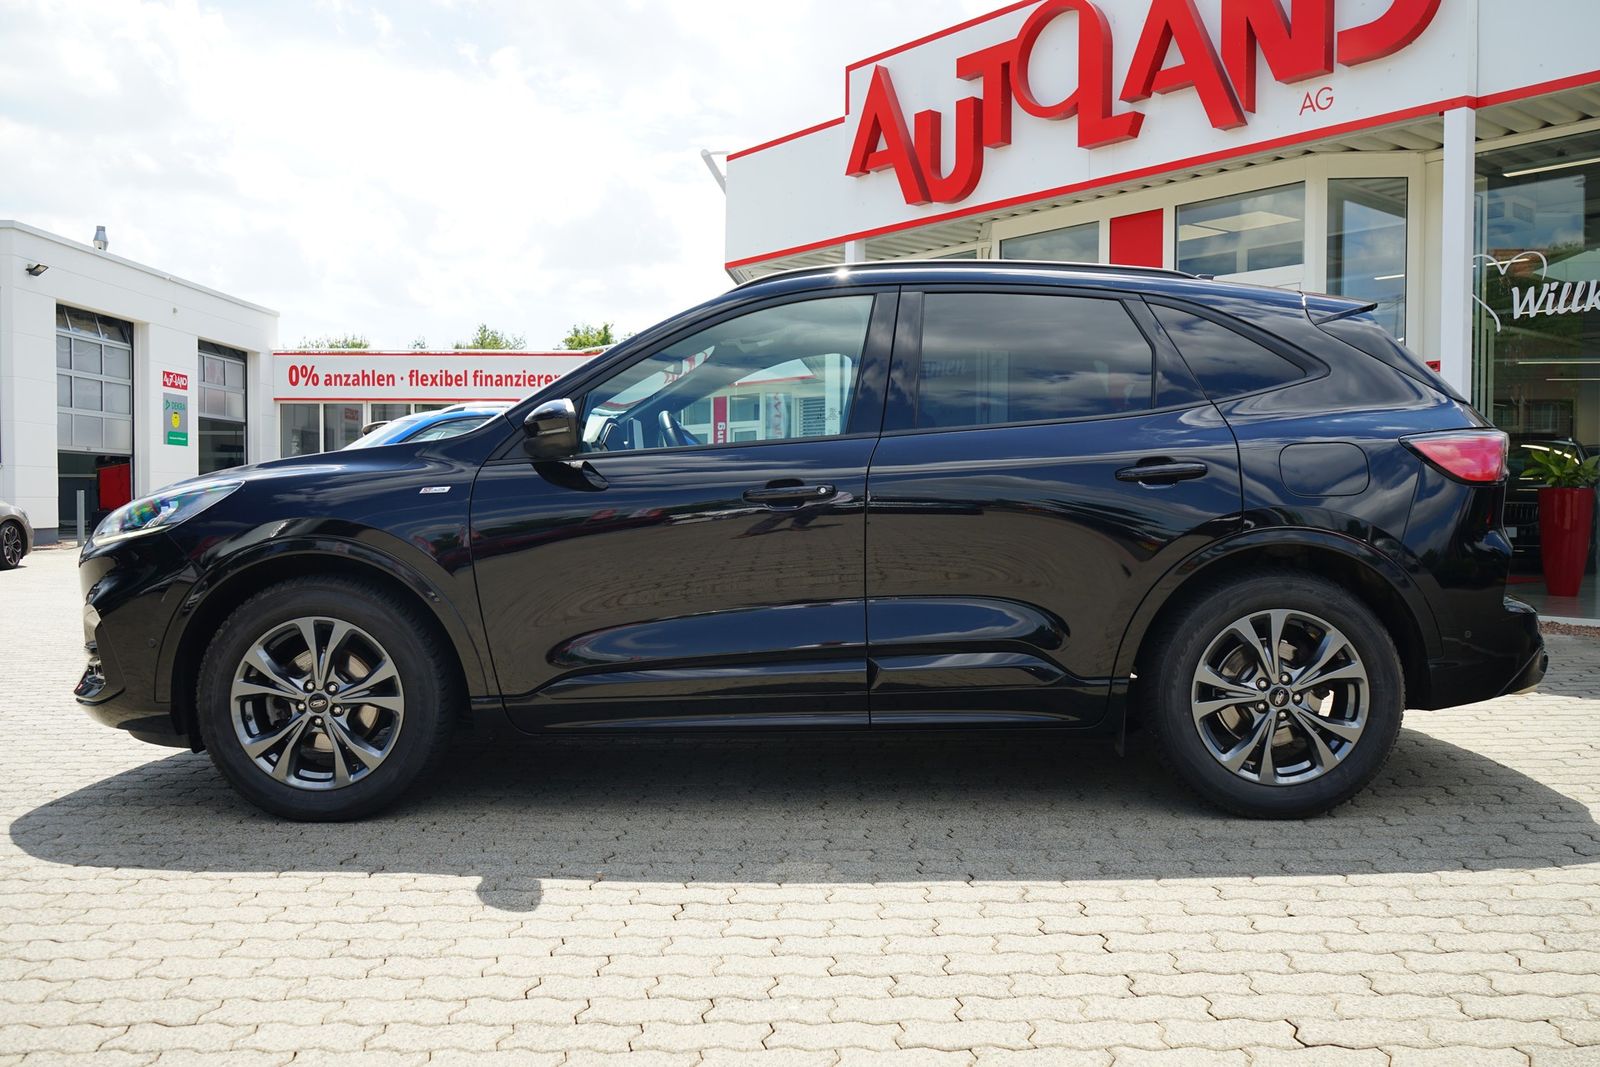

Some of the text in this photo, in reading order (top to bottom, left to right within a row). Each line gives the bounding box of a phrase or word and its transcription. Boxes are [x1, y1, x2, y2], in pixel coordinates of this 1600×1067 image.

[1299, 86, 1334, 116] AG
[288, 365, 319, 387] 0%
[323, 369, 395, 387] anzahlen
[408, 369, 467, 387] flexibel
